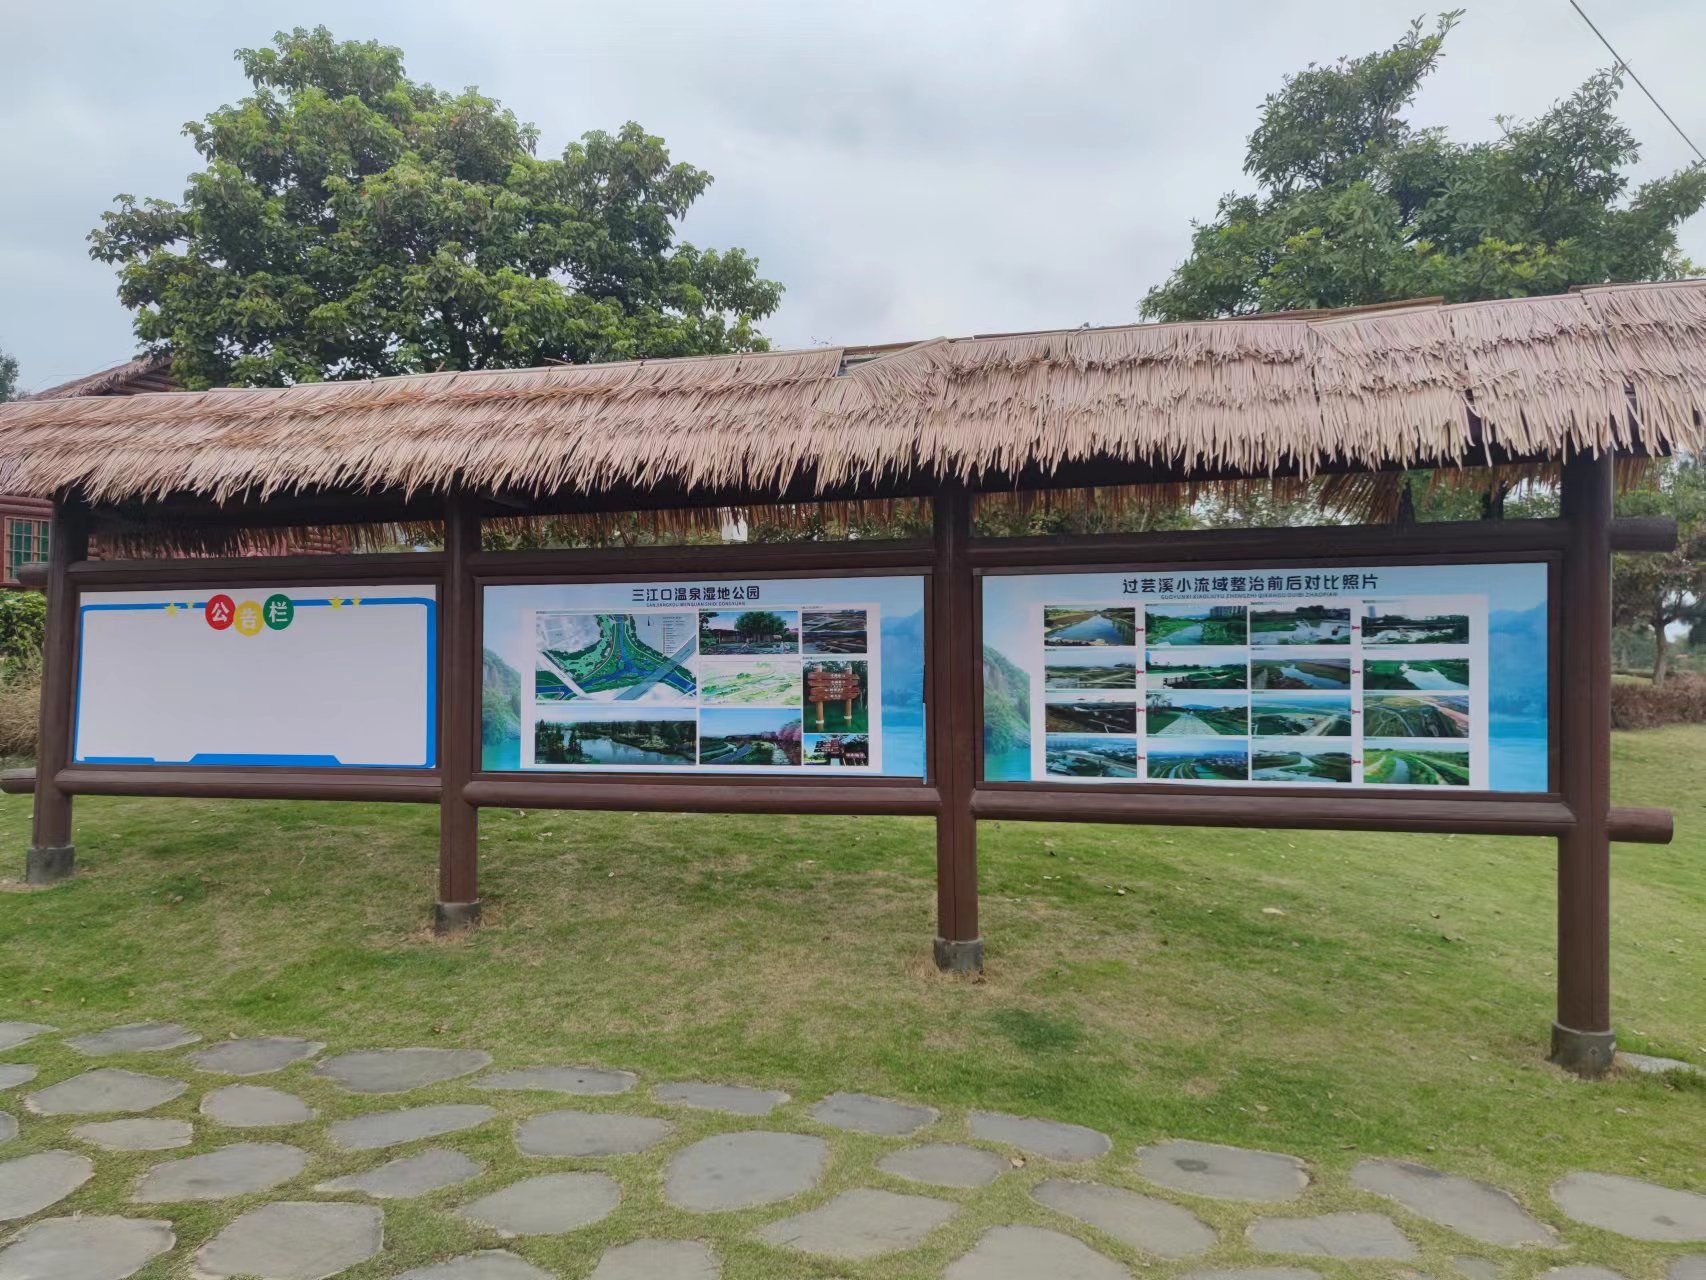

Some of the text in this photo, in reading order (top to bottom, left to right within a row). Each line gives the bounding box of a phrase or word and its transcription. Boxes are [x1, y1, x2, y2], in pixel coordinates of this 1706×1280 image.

[632, 585, 760, 602] 三江口温泉湿地公园
[1122, 573, 1379, 594] 过芸溪小流域整治前后对比照片
[211, 601, 288, 630] 公告栏
